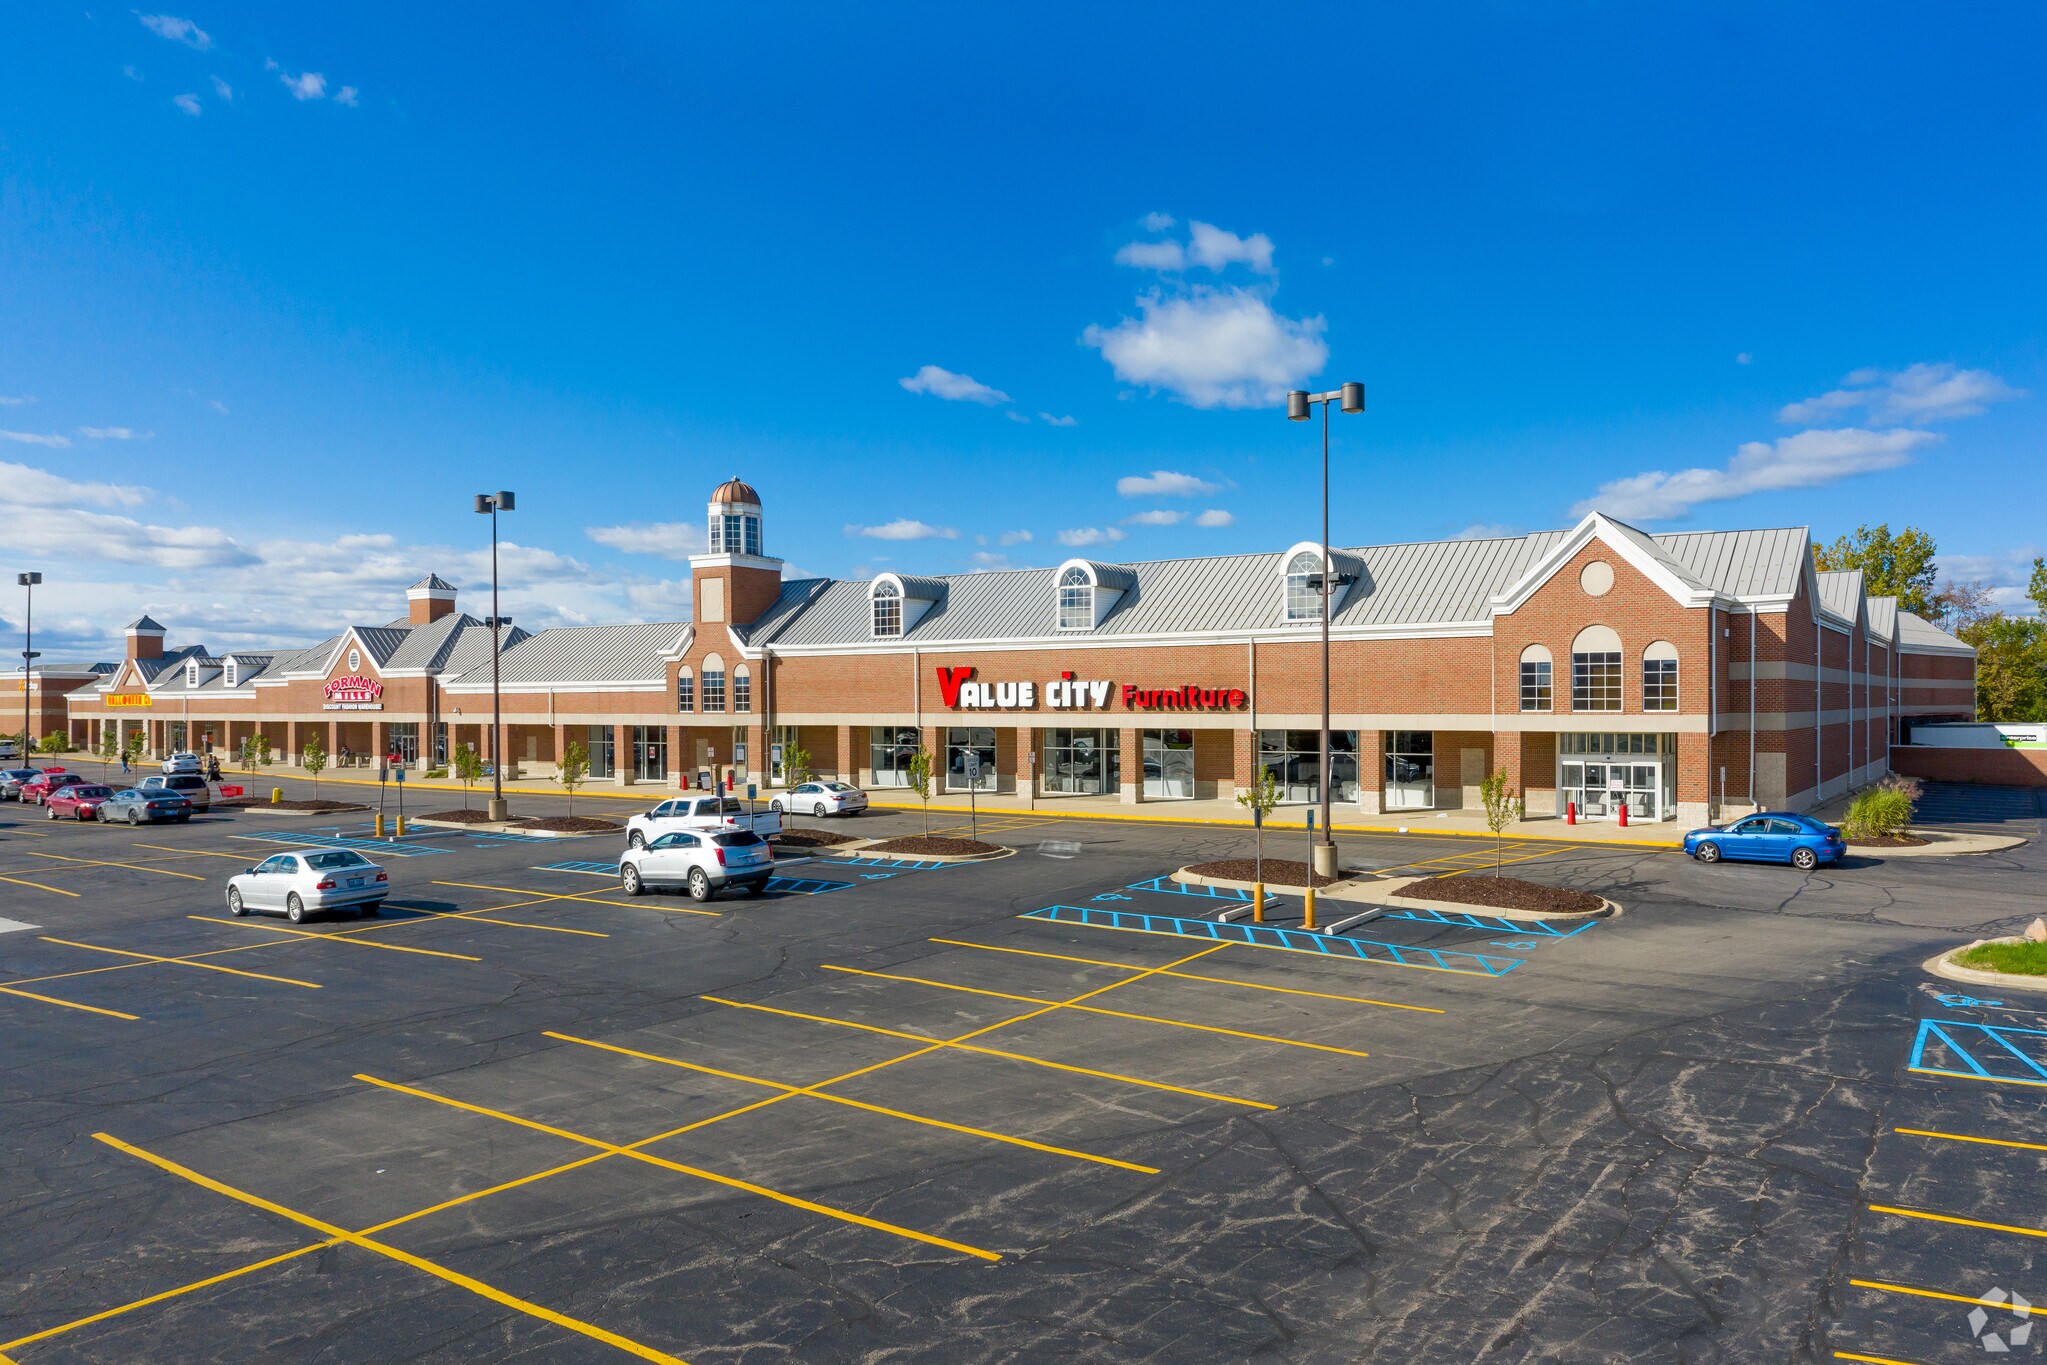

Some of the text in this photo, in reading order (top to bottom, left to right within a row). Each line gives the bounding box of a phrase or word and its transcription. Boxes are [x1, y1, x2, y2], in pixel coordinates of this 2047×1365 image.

[323, 675, 381, 698] FORMAN
[935, 666, 1034, 708] VALUE
[1122, 683, 1244, 708] Furniture
[334, 691, 371, 700] MILLS
[969, 767, 977, 776] 10
